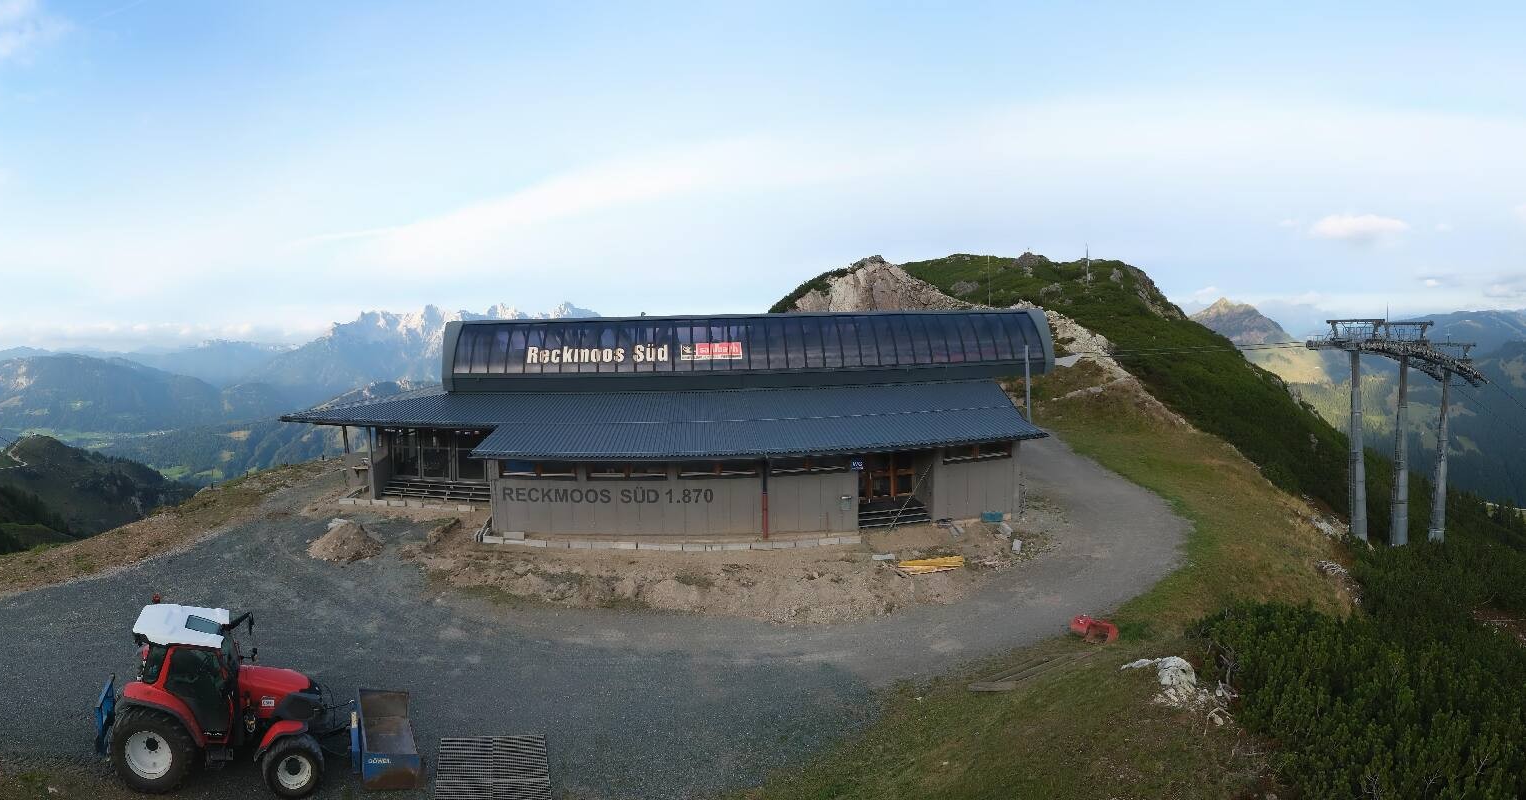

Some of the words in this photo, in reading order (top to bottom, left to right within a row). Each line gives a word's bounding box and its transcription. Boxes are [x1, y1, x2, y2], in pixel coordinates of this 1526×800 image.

[526, 346, 625, 364] Reckmoos
[632, 344, 669, 363] Süd
[502, 486, 611, 504] RECKMOOS
[620, 486, 660, 504] SÜD
[665, 488, 714, 503] 1.870
